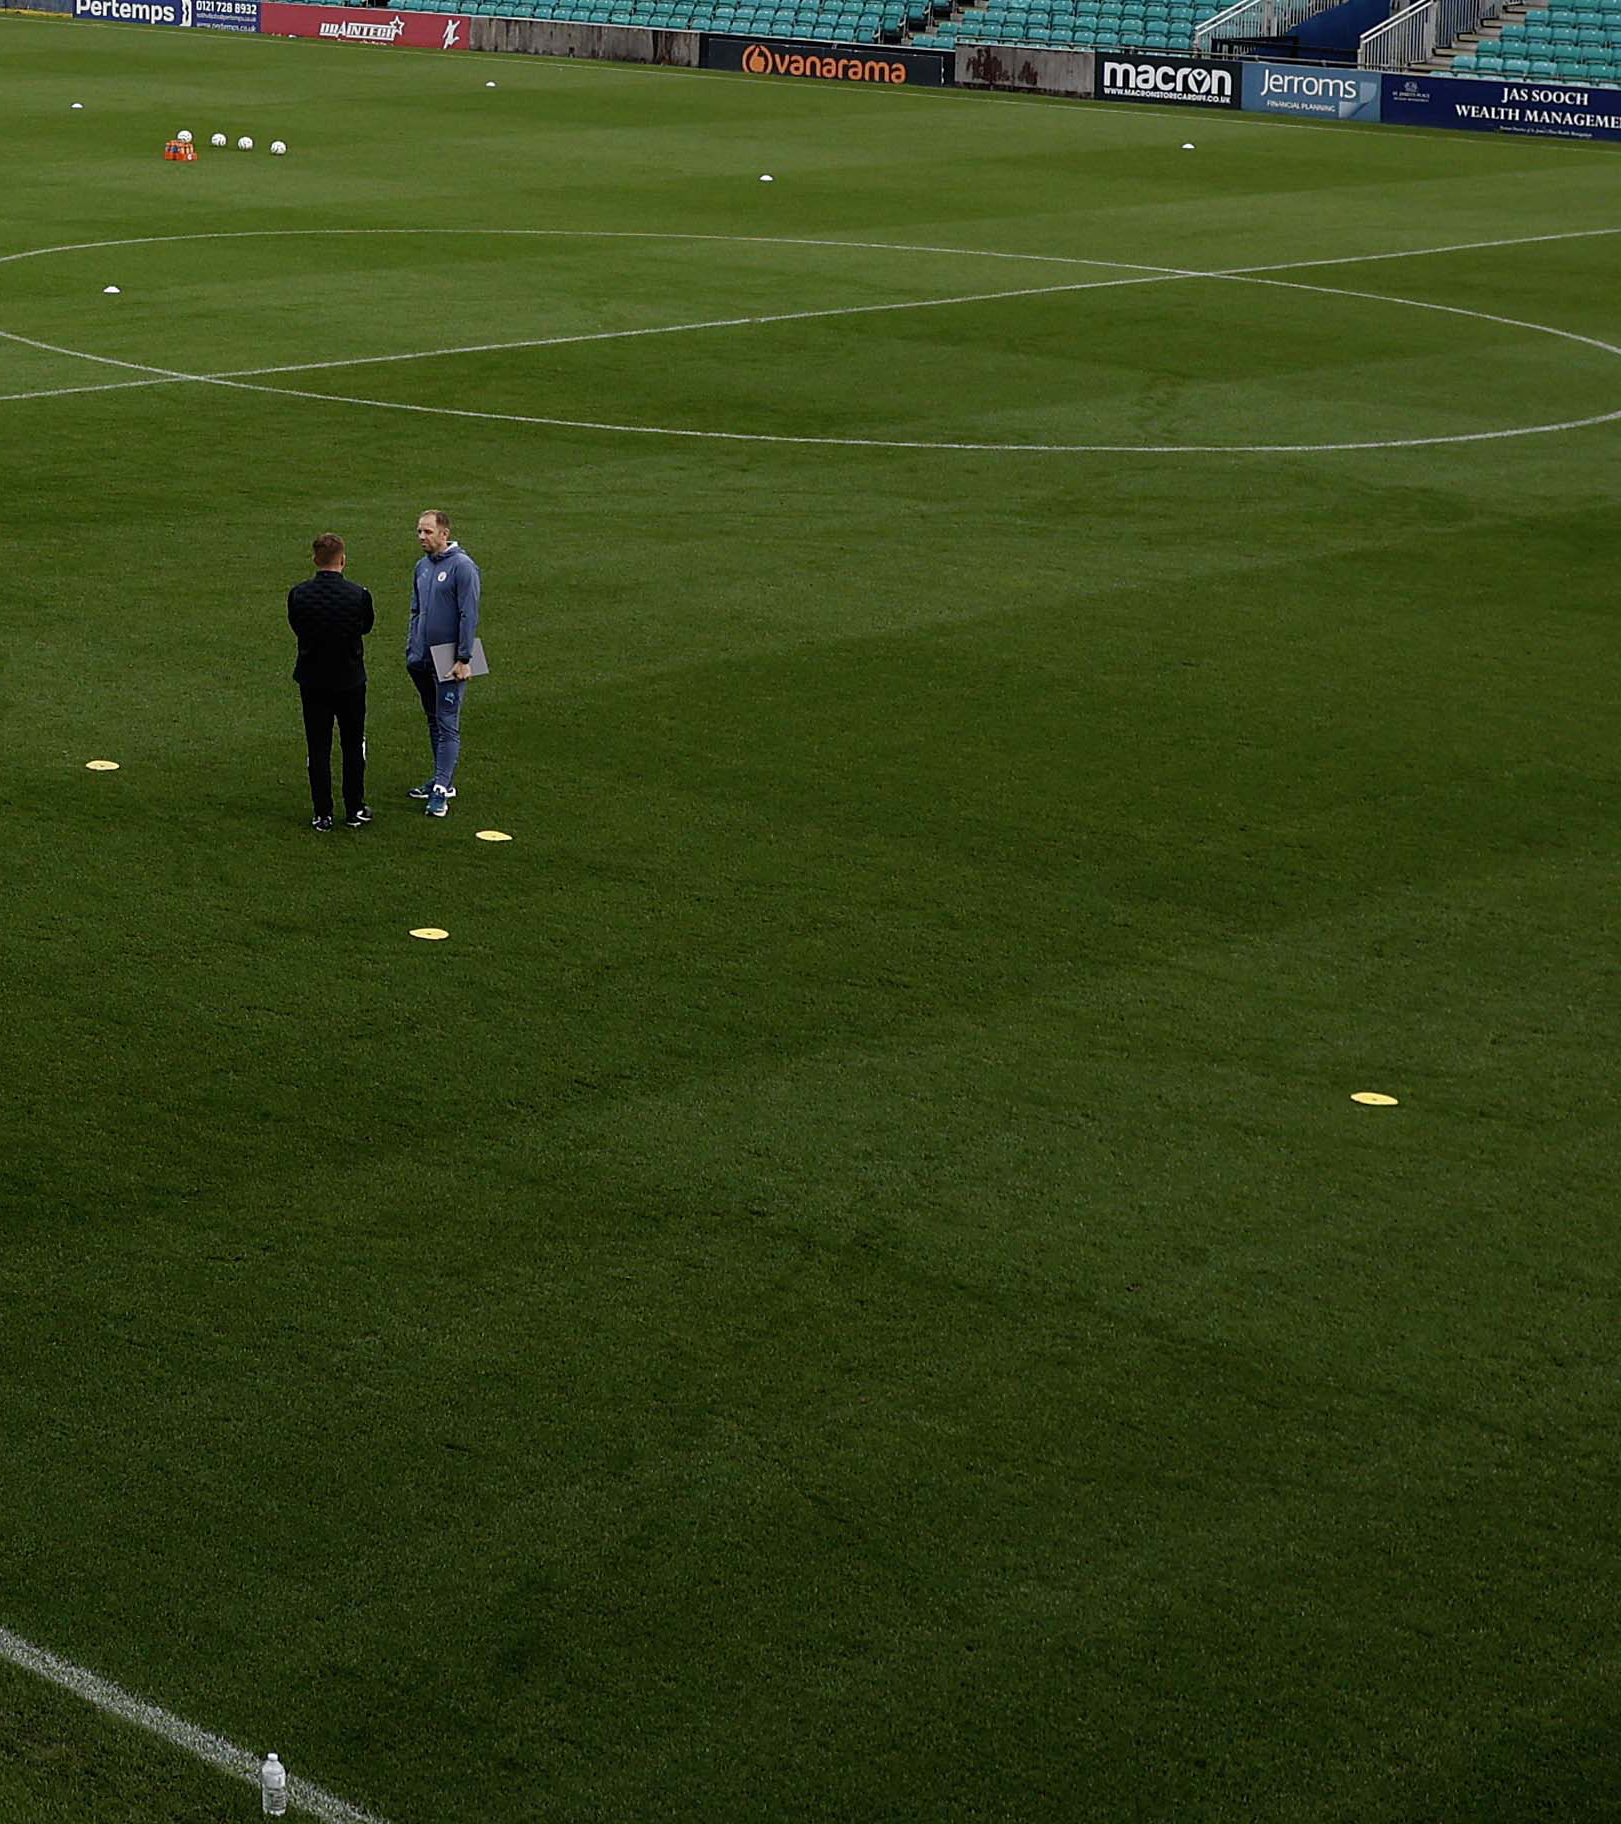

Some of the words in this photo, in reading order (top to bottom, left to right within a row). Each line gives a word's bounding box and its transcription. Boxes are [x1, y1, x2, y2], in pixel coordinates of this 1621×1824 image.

[196, 0, 214, 12] 0121
[216, 2, 233, 13] 728
[235, 3, 257, 15] 8932
[319, 20, 396, 41] DRAINTECH
[774, 53, 906, 84] vanarama
[1104, 61, 1232, 95] macron
[1261, 68, 1356, 98] Jerroms
[1501, 87, 1528, 104] JAS
[1531, 89, 1589, 106] SOOCH
[1455, 104, 1520, 121] WEALTH
[1524, 109, 1621, 129] MANAGEME
